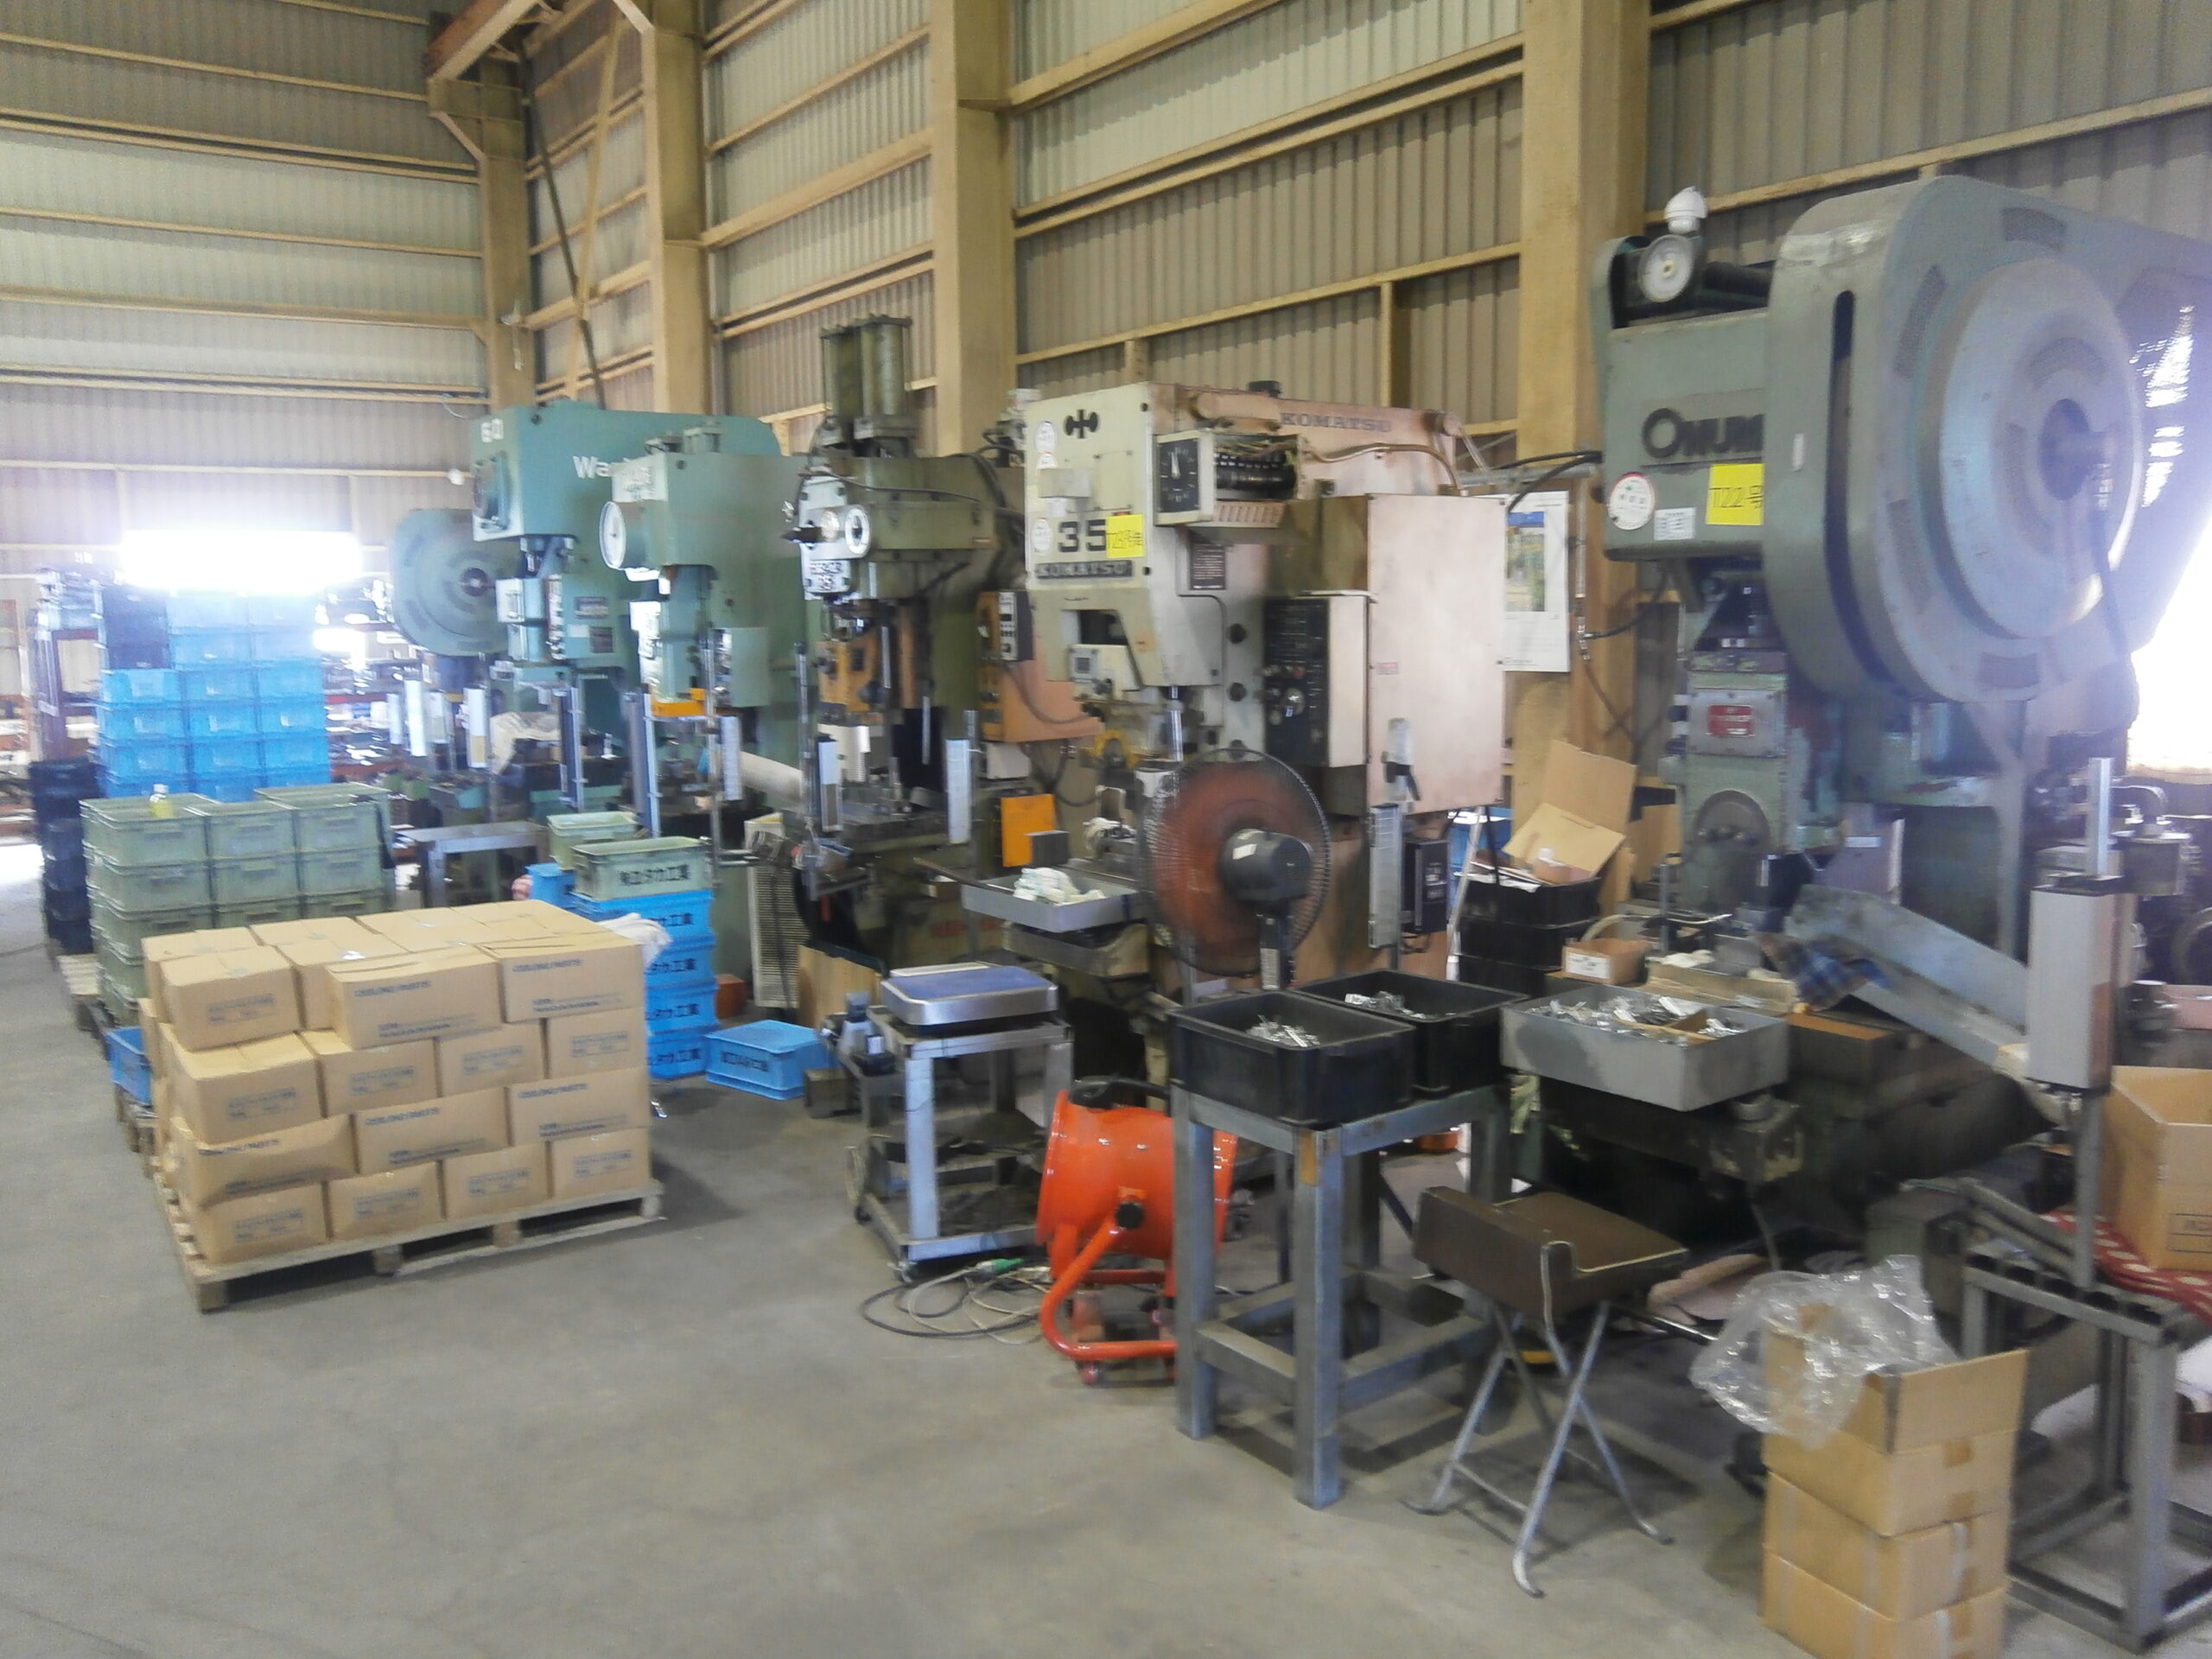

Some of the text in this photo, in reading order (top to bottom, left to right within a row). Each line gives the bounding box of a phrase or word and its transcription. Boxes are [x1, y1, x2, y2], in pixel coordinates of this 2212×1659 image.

[1280, 412, 1390, 432] KOMATSU
[1058, 519, 1107, 553] 35
[1037, 563, 1128, 578] KOMATSU
